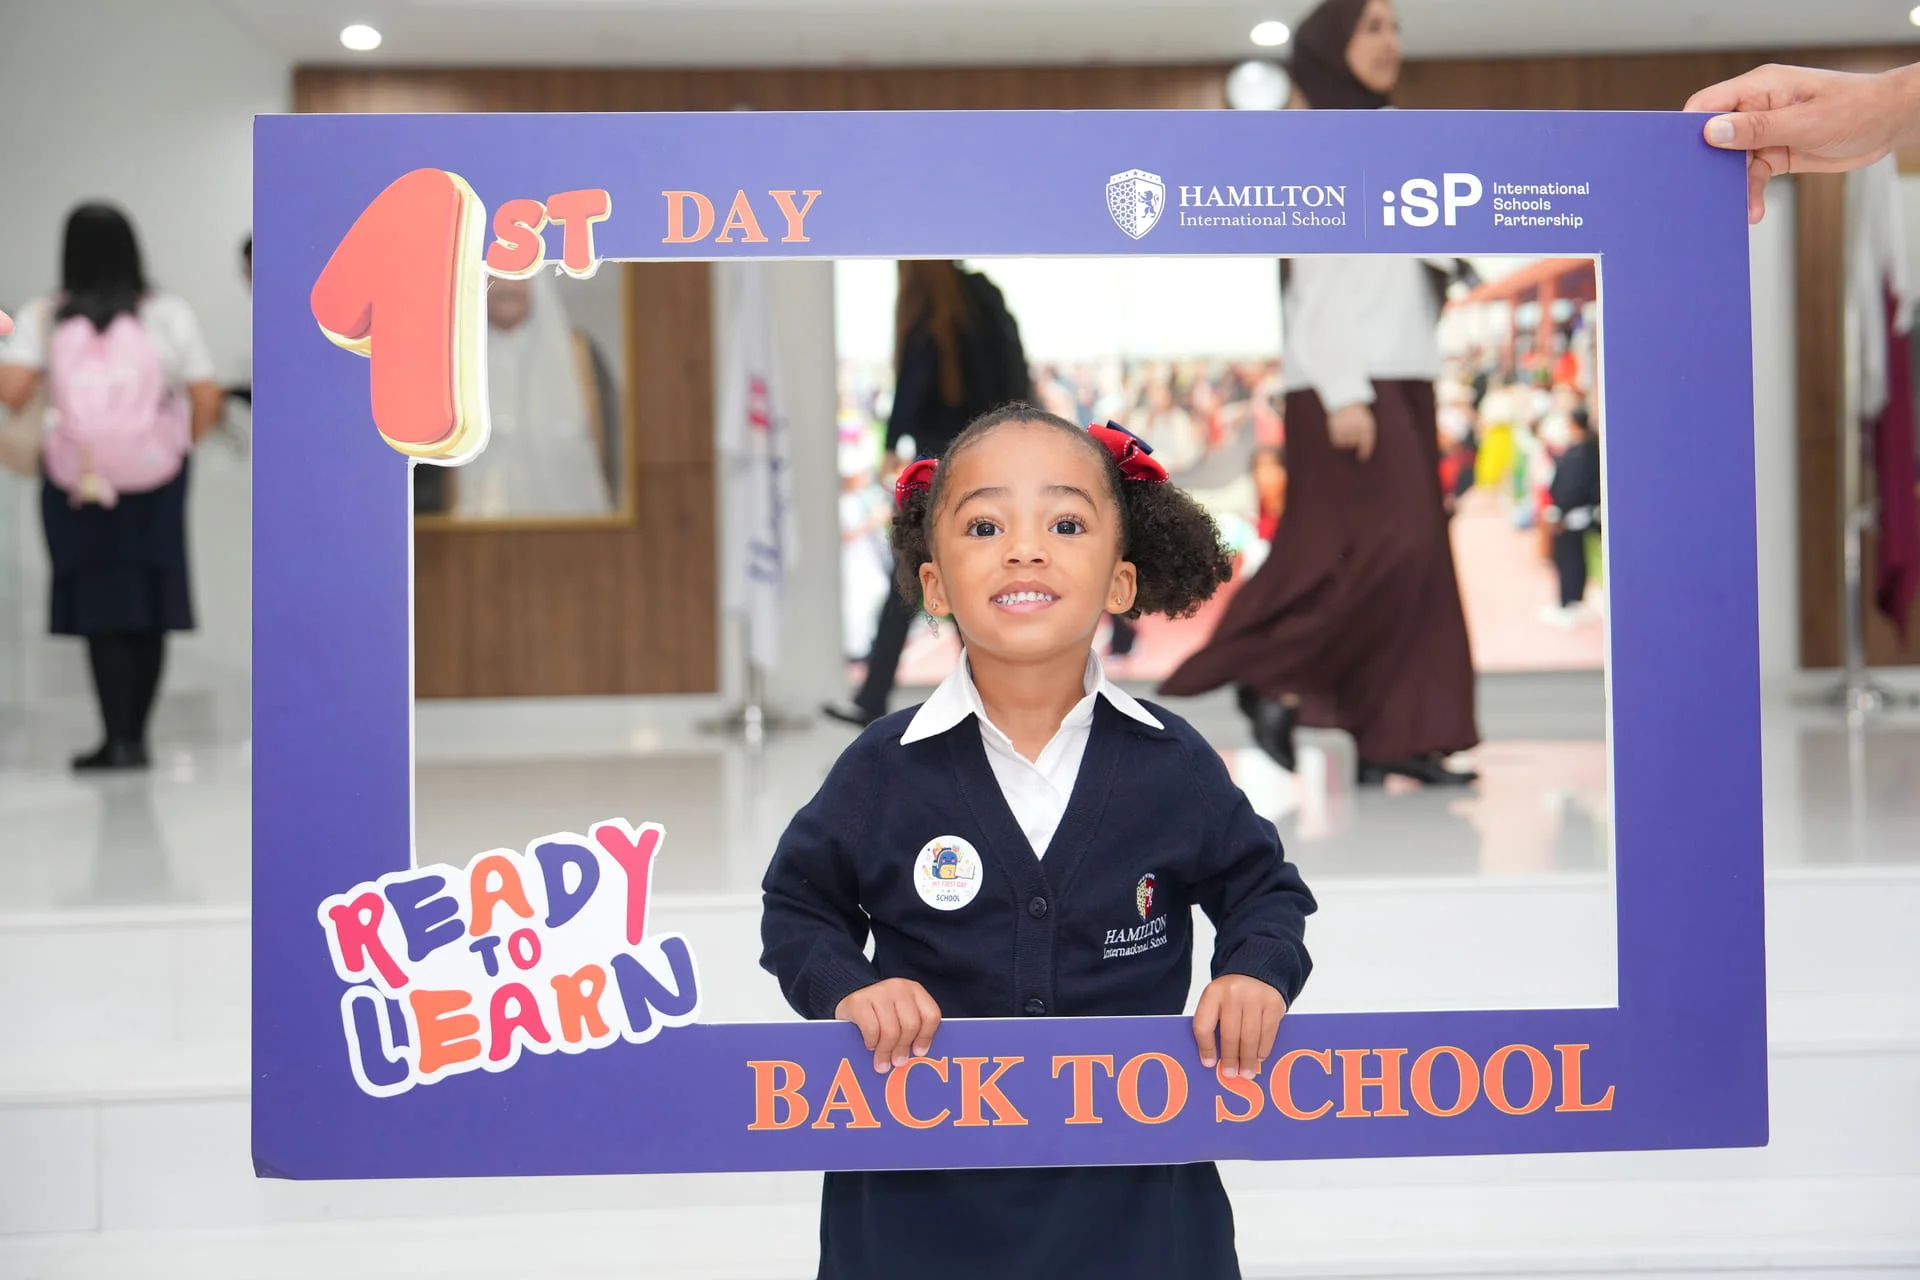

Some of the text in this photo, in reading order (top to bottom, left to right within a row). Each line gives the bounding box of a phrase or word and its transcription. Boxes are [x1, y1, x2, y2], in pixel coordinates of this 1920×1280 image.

[1178, 185, 1347, 208] HAMILTON
[1382, 172, 1483, 228] iSP
[1493, 182, 1590, 196] International
[1493, 197, 1552, 211] Schools
[1179, 211, 1347, 227] International School
[1494, 213, 1584, 229] Partnership
[310, 167, 822, 459] 1ST DAY
[328, 825, 660, 990] READY
[935, 894, 960, 902] SCHOOL
[1104, 913, 1167, 945] HAMILTON
[469, 928, 542, 977] TO
[351, 936, 699, 1088] LEARN
[746, 1043, 1616, 1131] BACK TO SCHOOL
